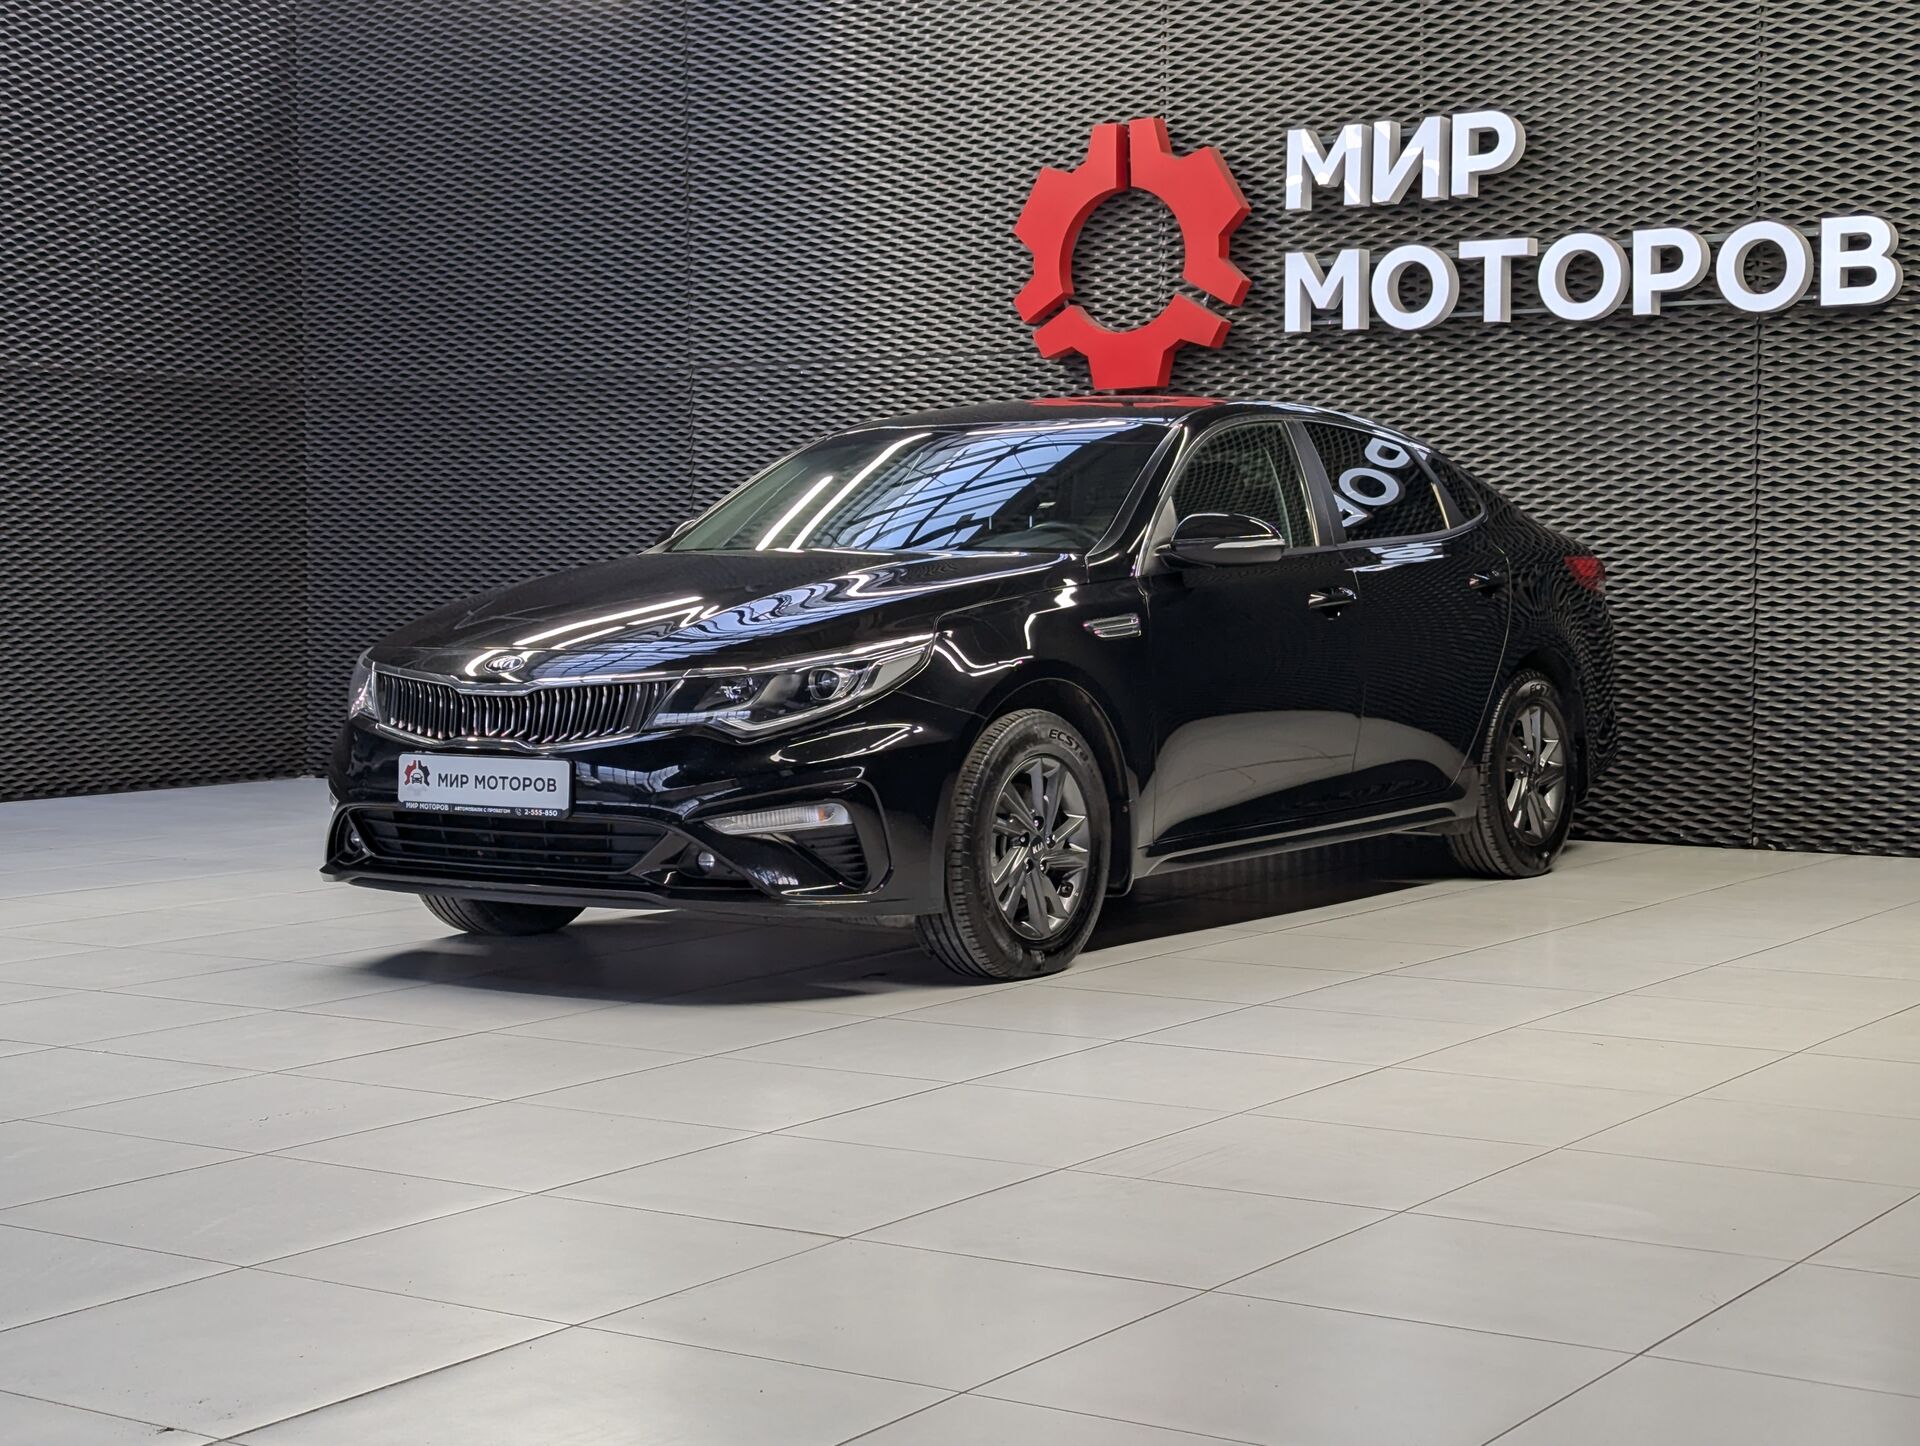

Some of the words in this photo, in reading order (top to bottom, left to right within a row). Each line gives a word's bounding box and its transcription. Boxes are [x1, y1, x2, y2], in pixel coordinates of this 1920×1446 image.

[1285, 110, 1526, 210] МИР
[1284, 215, 1903, 332] МОТОРОВ
[405, 801, 419, 809] МИР
[420, 803, 449, 811] МОТОРОВ
[524, 808, 558, 816] 2-555-850
[438, 773, 469, 789] МИР
[474, 775, 557, 792] МОТОРОВ
